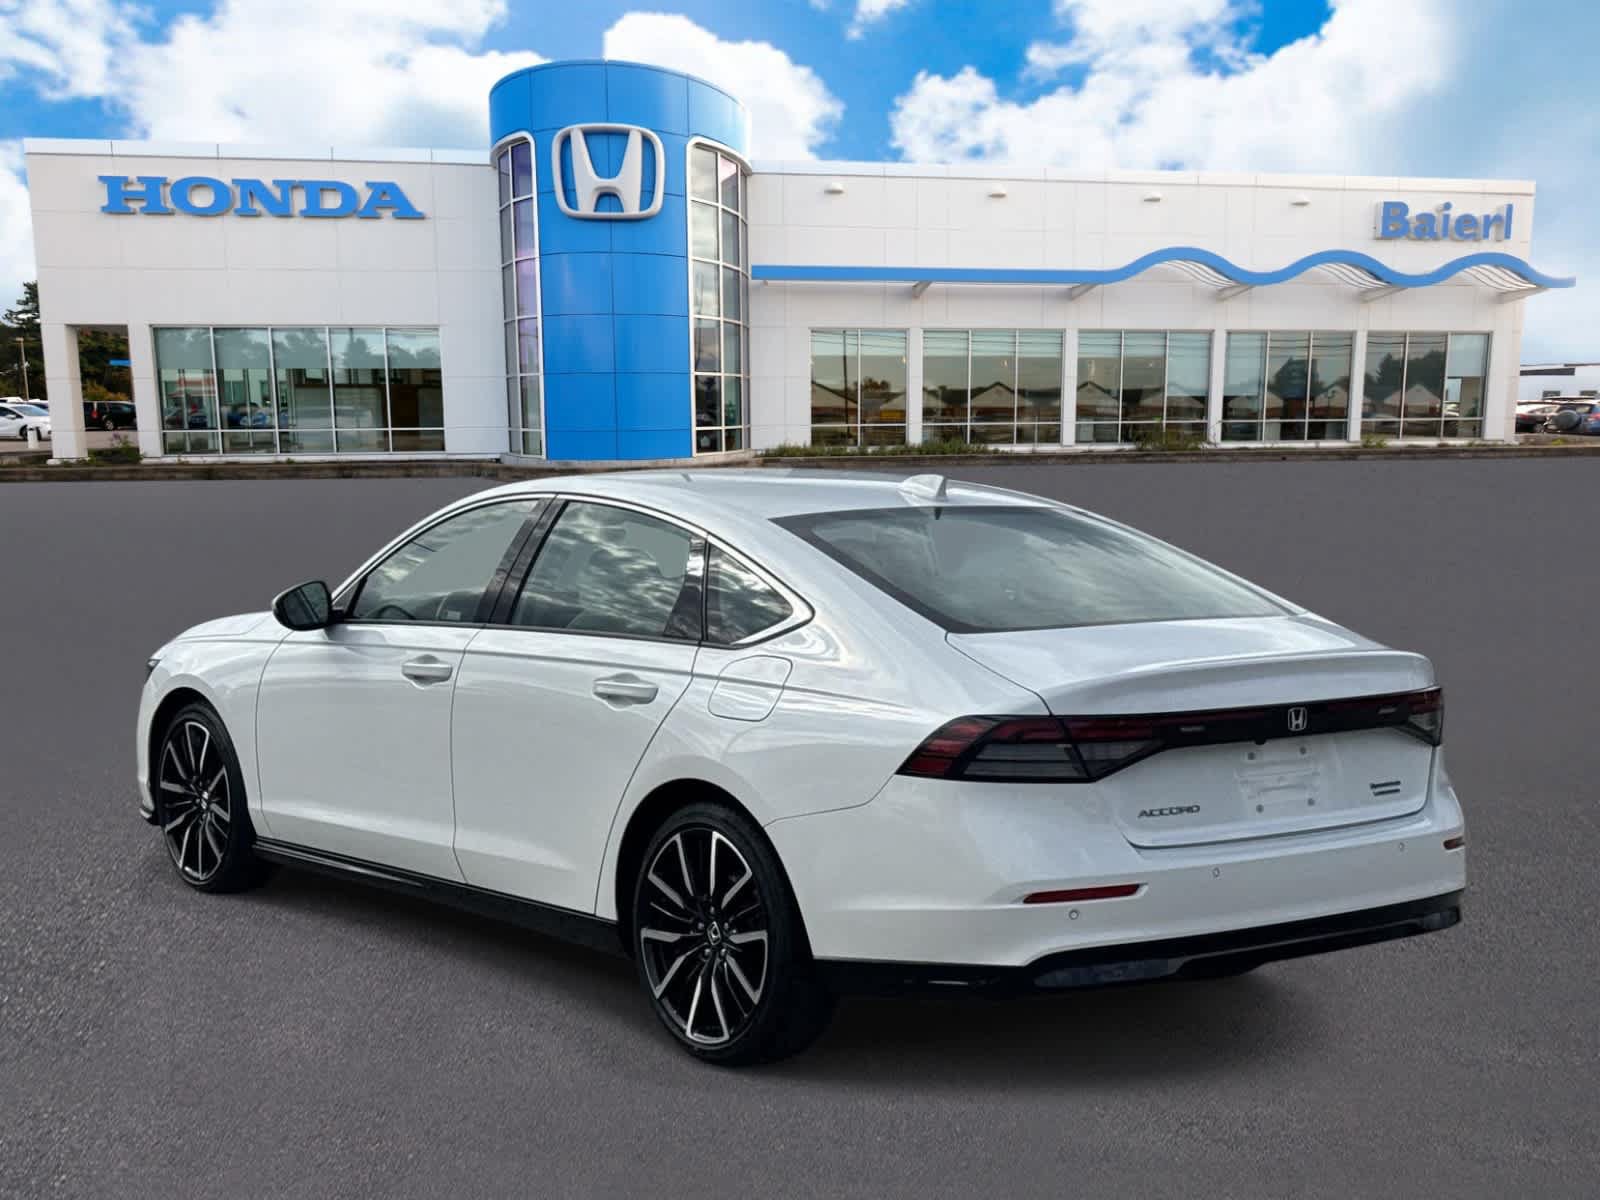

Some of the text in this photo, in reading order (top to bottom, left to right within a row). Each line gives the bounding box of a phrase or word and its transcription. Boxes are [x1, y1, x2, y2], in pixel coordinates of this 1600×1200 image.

[98, 175, 426, 219] HONDA
[1380, 201, 1514, 240] Baierl
[1137, 804, 1201, 819] ACCORD
